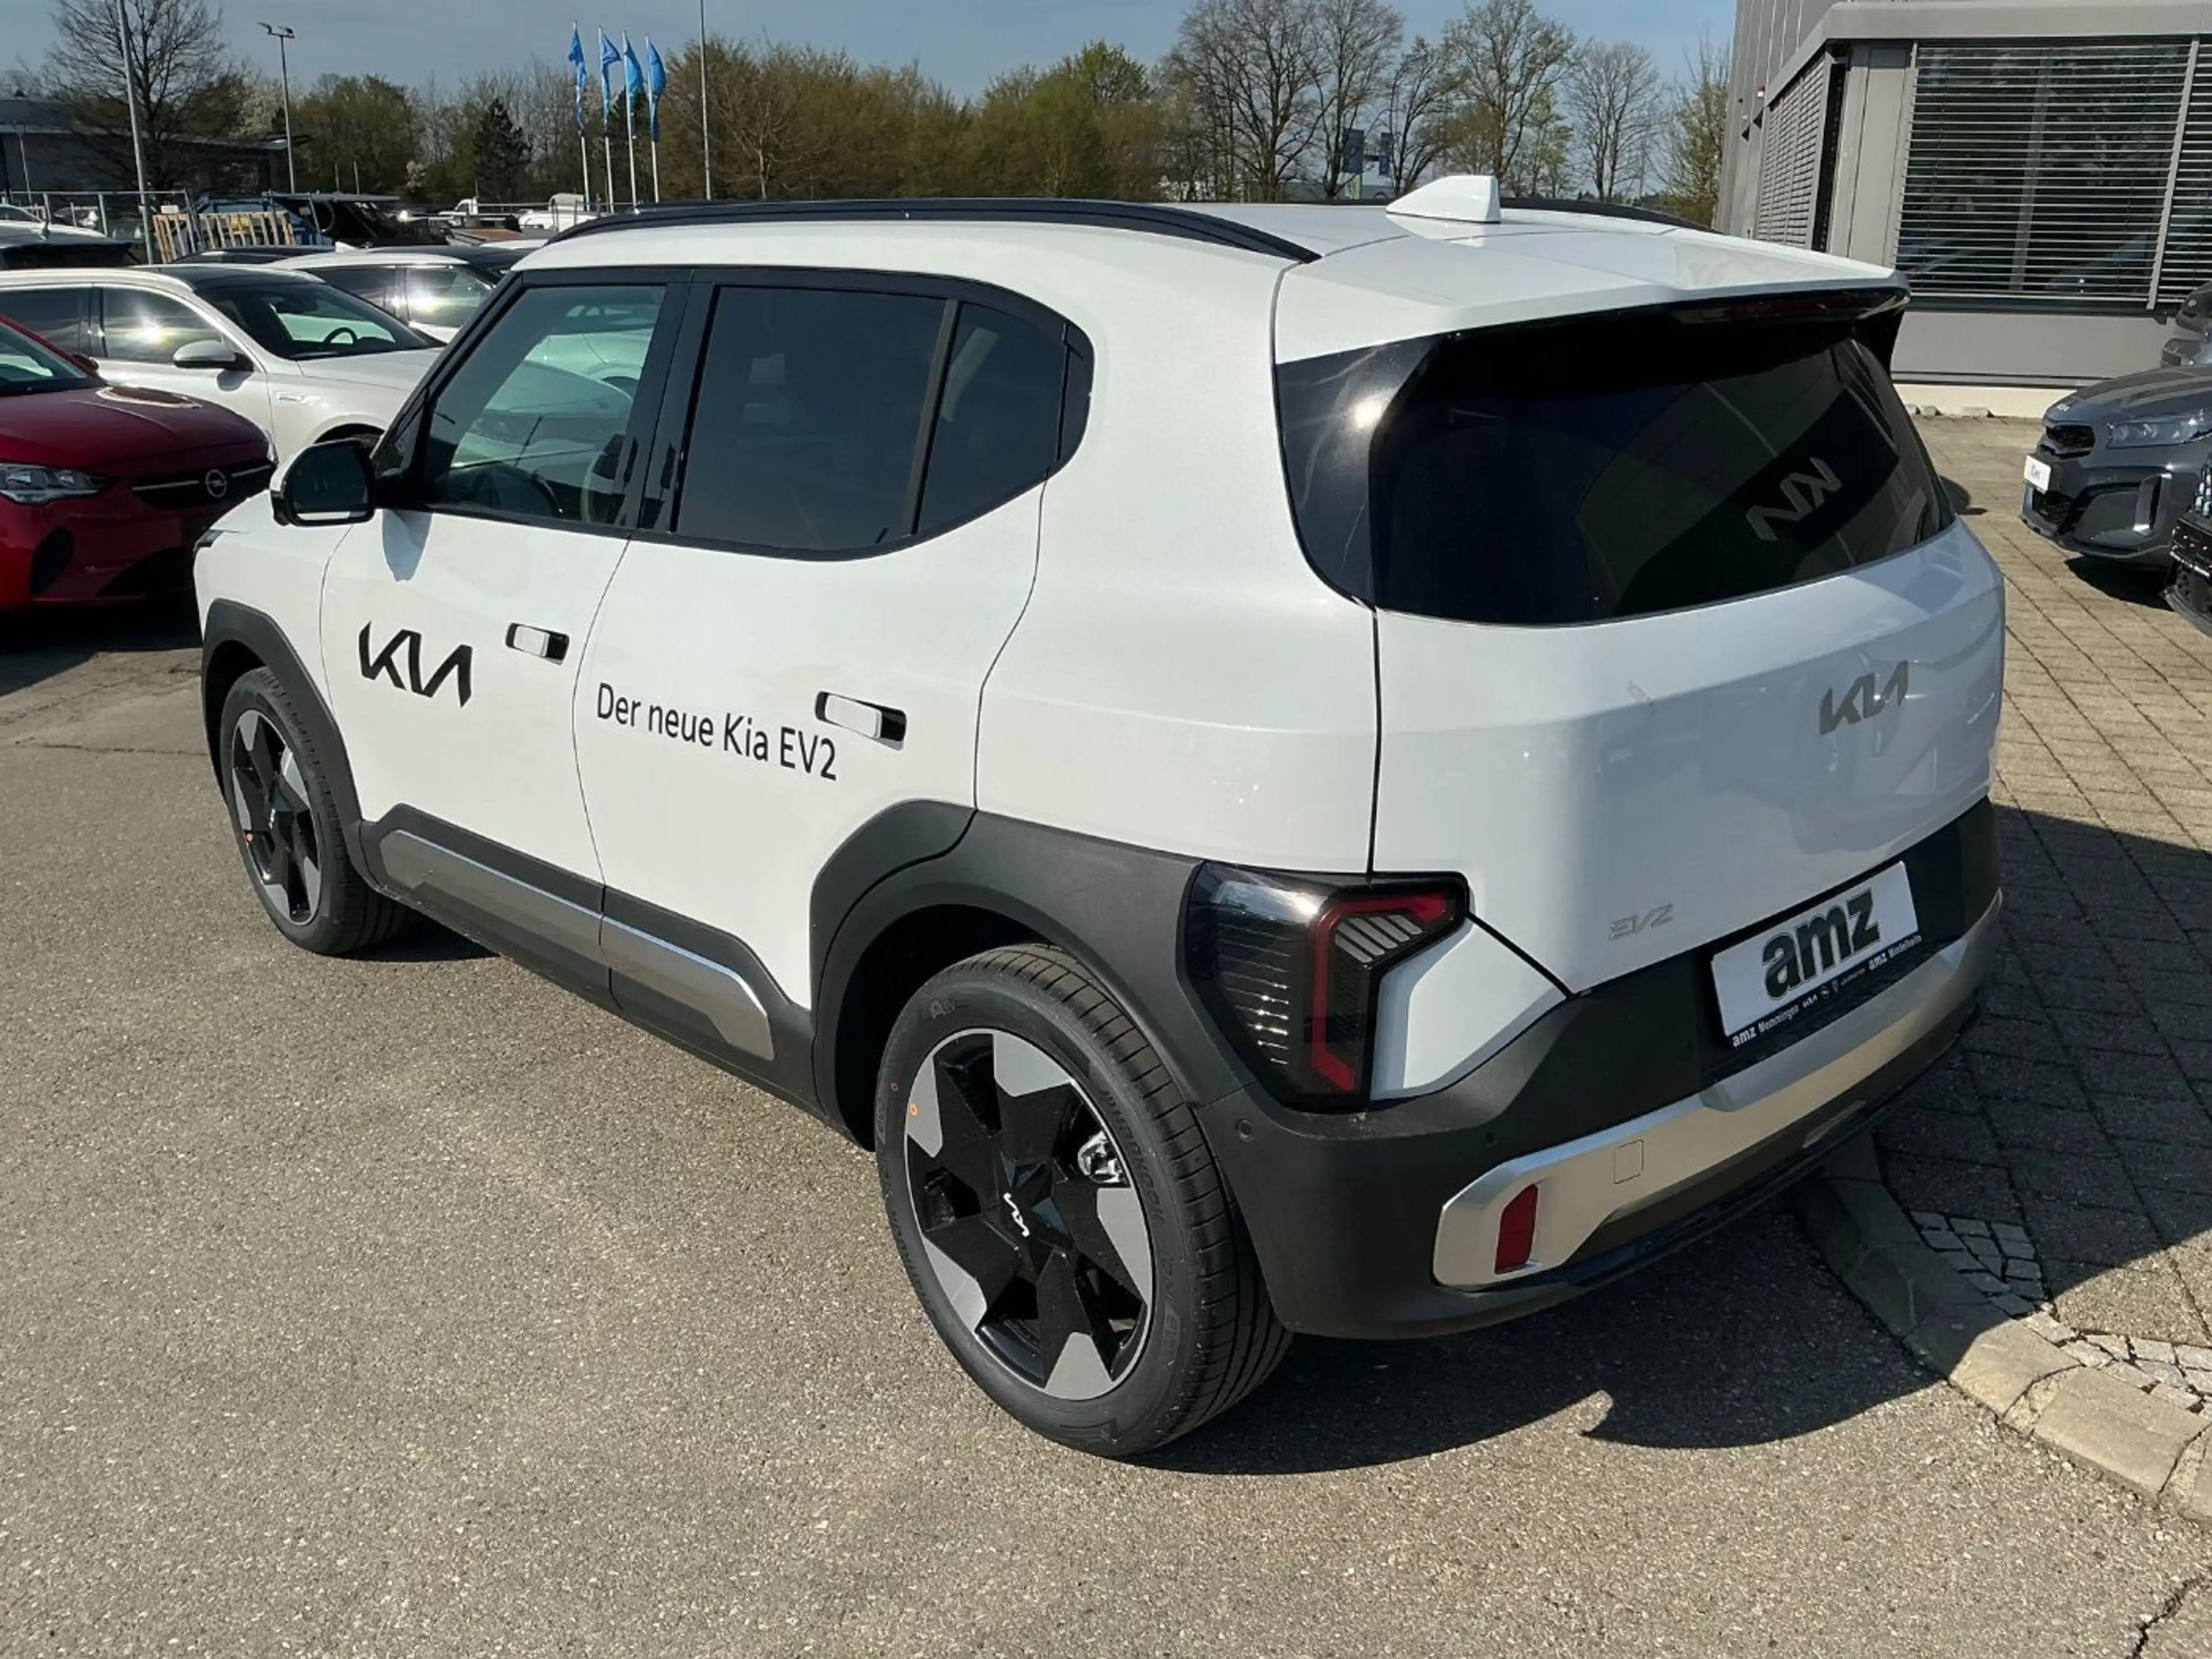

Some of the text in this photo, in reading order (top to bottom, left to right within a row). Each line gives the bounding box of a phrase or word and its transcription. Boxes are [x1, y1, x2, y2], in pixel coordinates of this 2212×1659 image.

[358, 621, 473, 708] KIA
[1819, 659, 1910, 735] KIA
[597, 682, 837, 782] Der neue Kia EV2
[1608, 902, 1675, 941] EV2
[1762, 887, 1880, 1001] amz
[1733, 1026, 1756, 1047] amz
